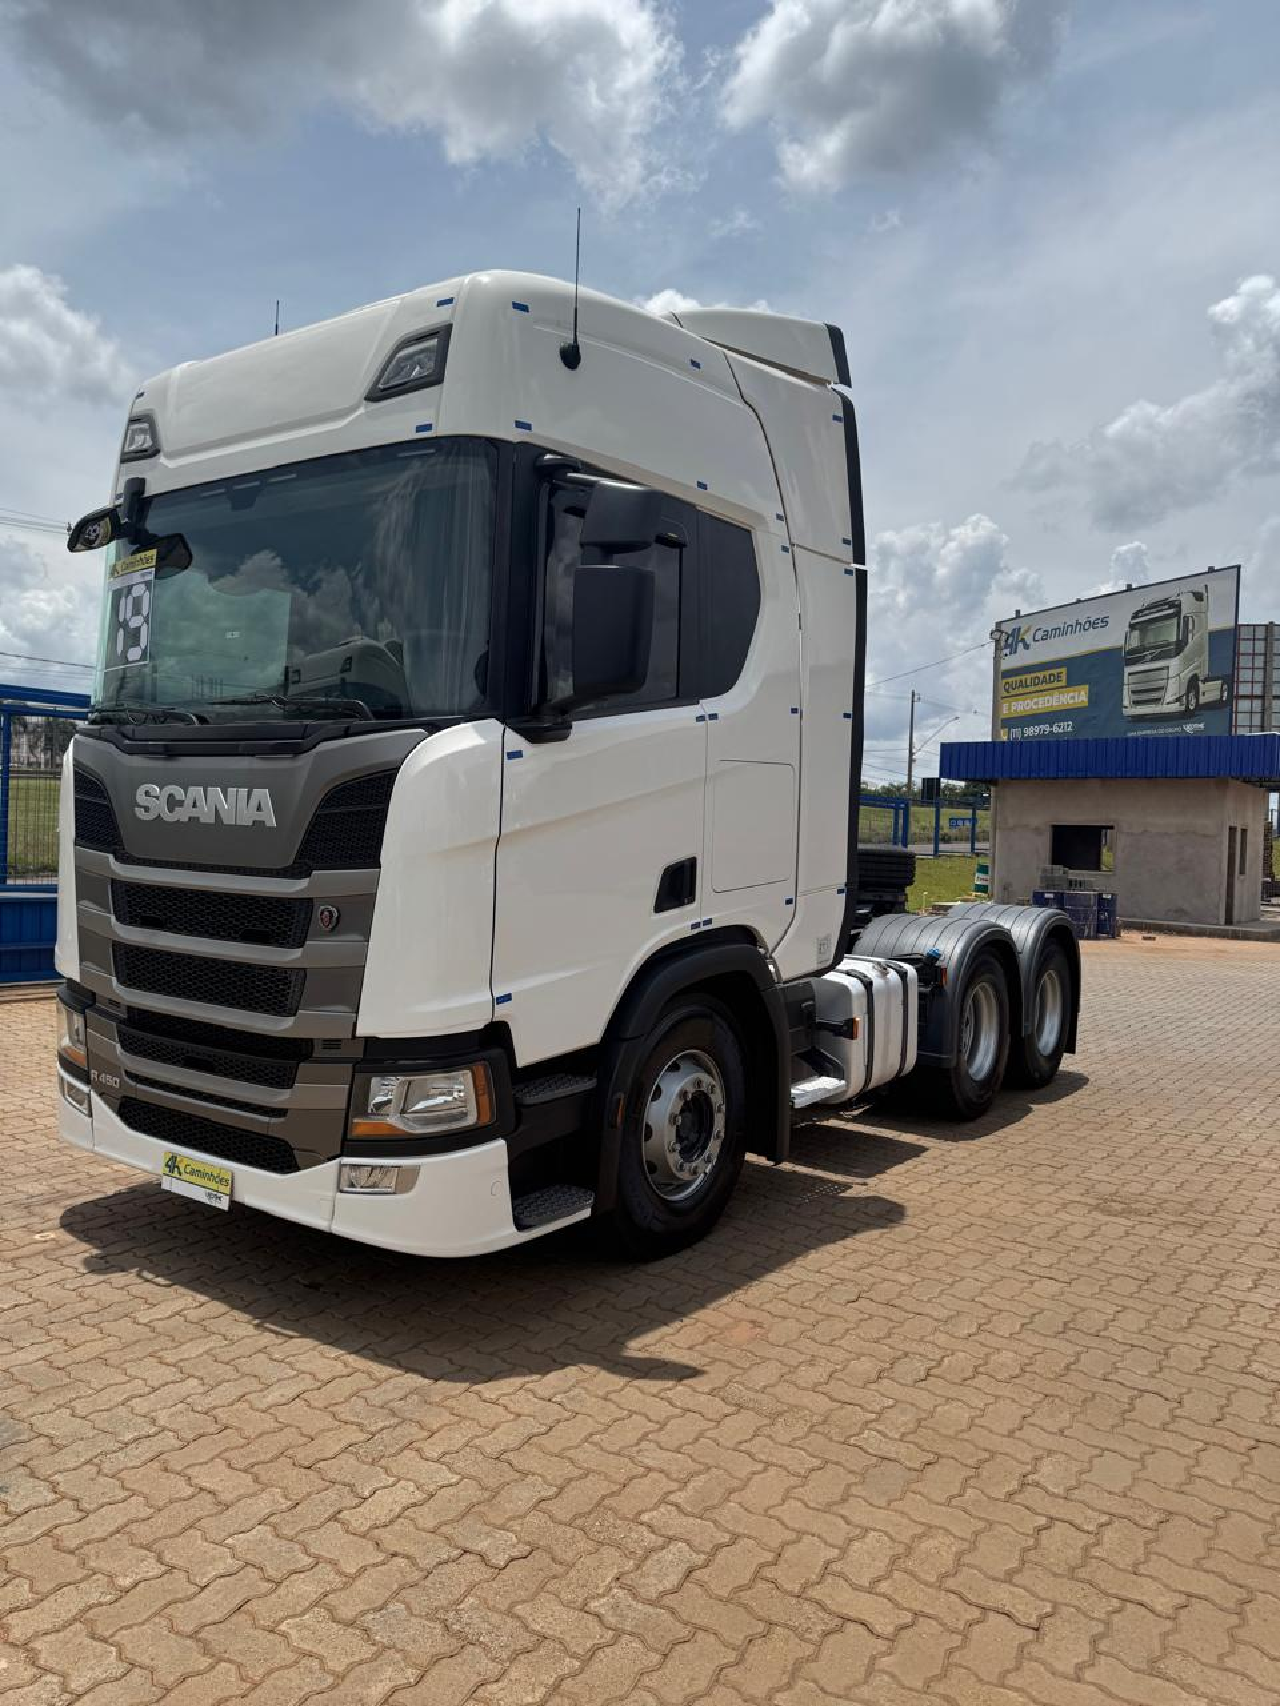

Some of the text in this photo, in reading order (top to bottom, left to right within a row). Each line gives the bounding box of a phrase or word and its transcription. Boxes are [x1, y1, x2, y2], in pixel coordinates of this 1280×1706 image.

[1033, 616, 1109, 642] Caminhões
[1003, 671, 1064, 693] QUALIDADE
[1003, 703, 1009, 714] E
[135, 783, 277, 827] SCANIA
[184, 1164, 230, 1187] Caminhões
